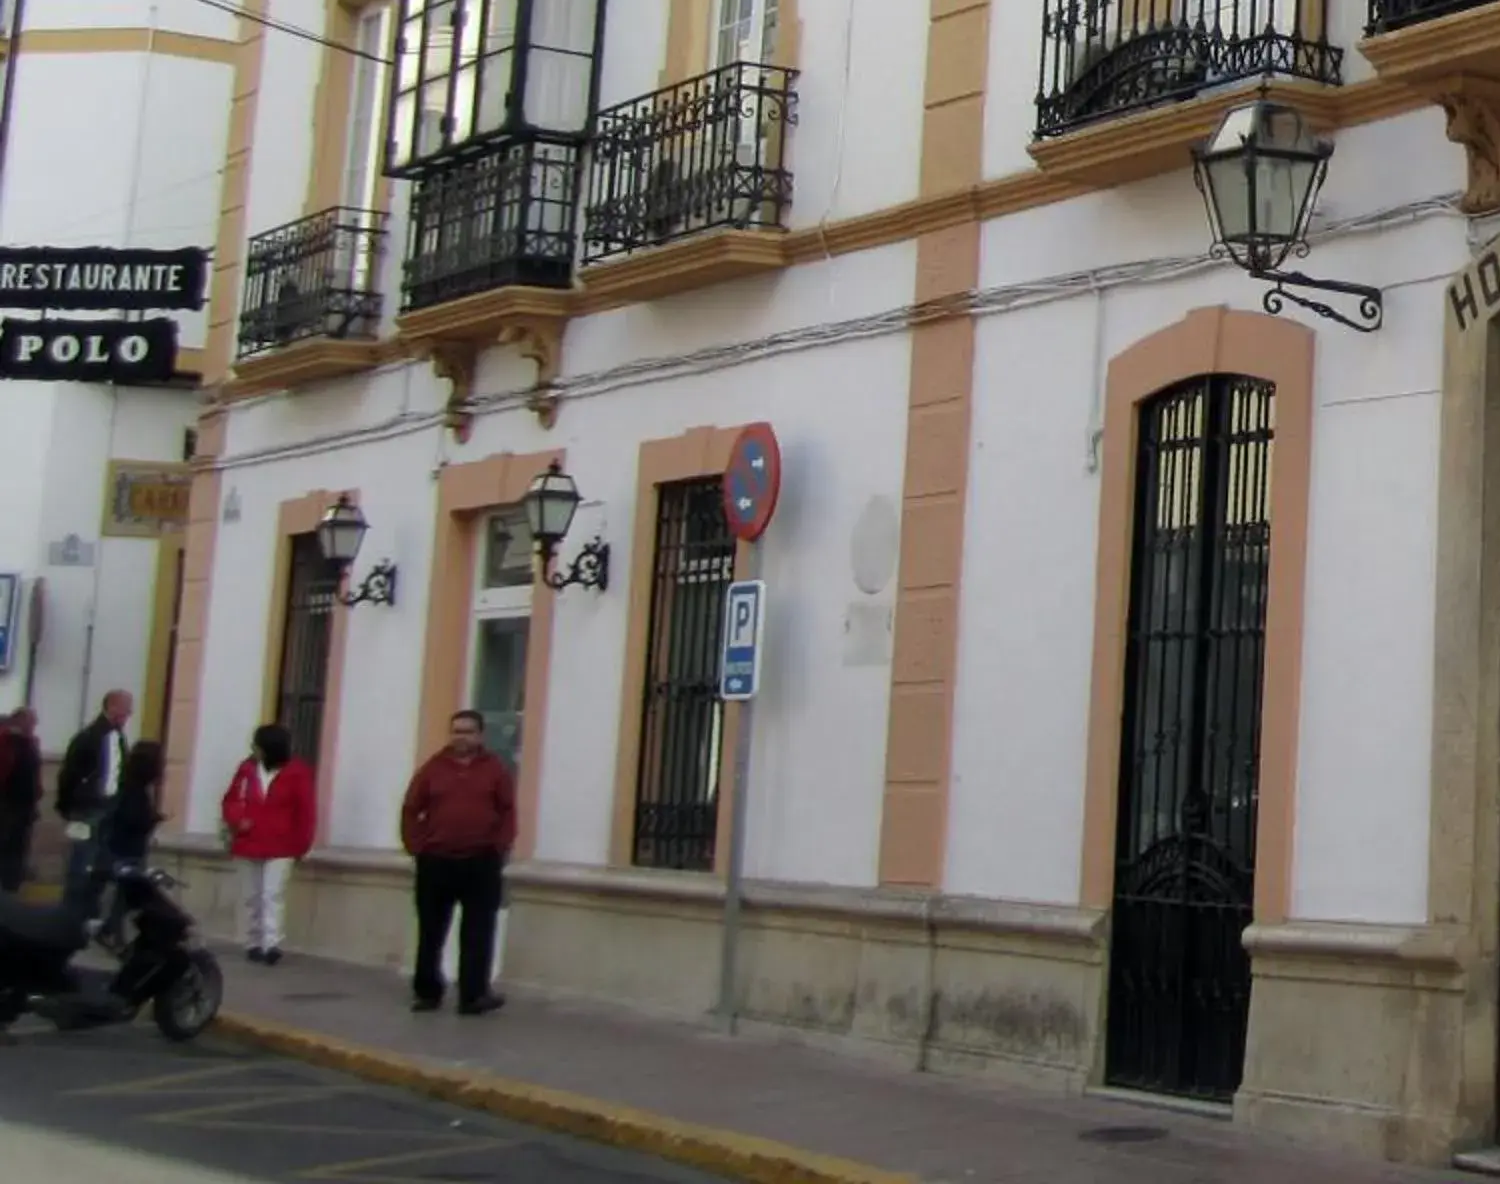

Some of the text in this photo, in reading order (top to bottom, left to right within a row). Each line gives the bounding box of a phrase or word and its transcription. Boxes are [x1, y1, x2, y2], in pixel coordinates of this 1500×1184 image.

[1, 263, 185, 291] RESTAURANTE
[16, 335, 149, 363] POLO
[735, 601, 751, 641] P
